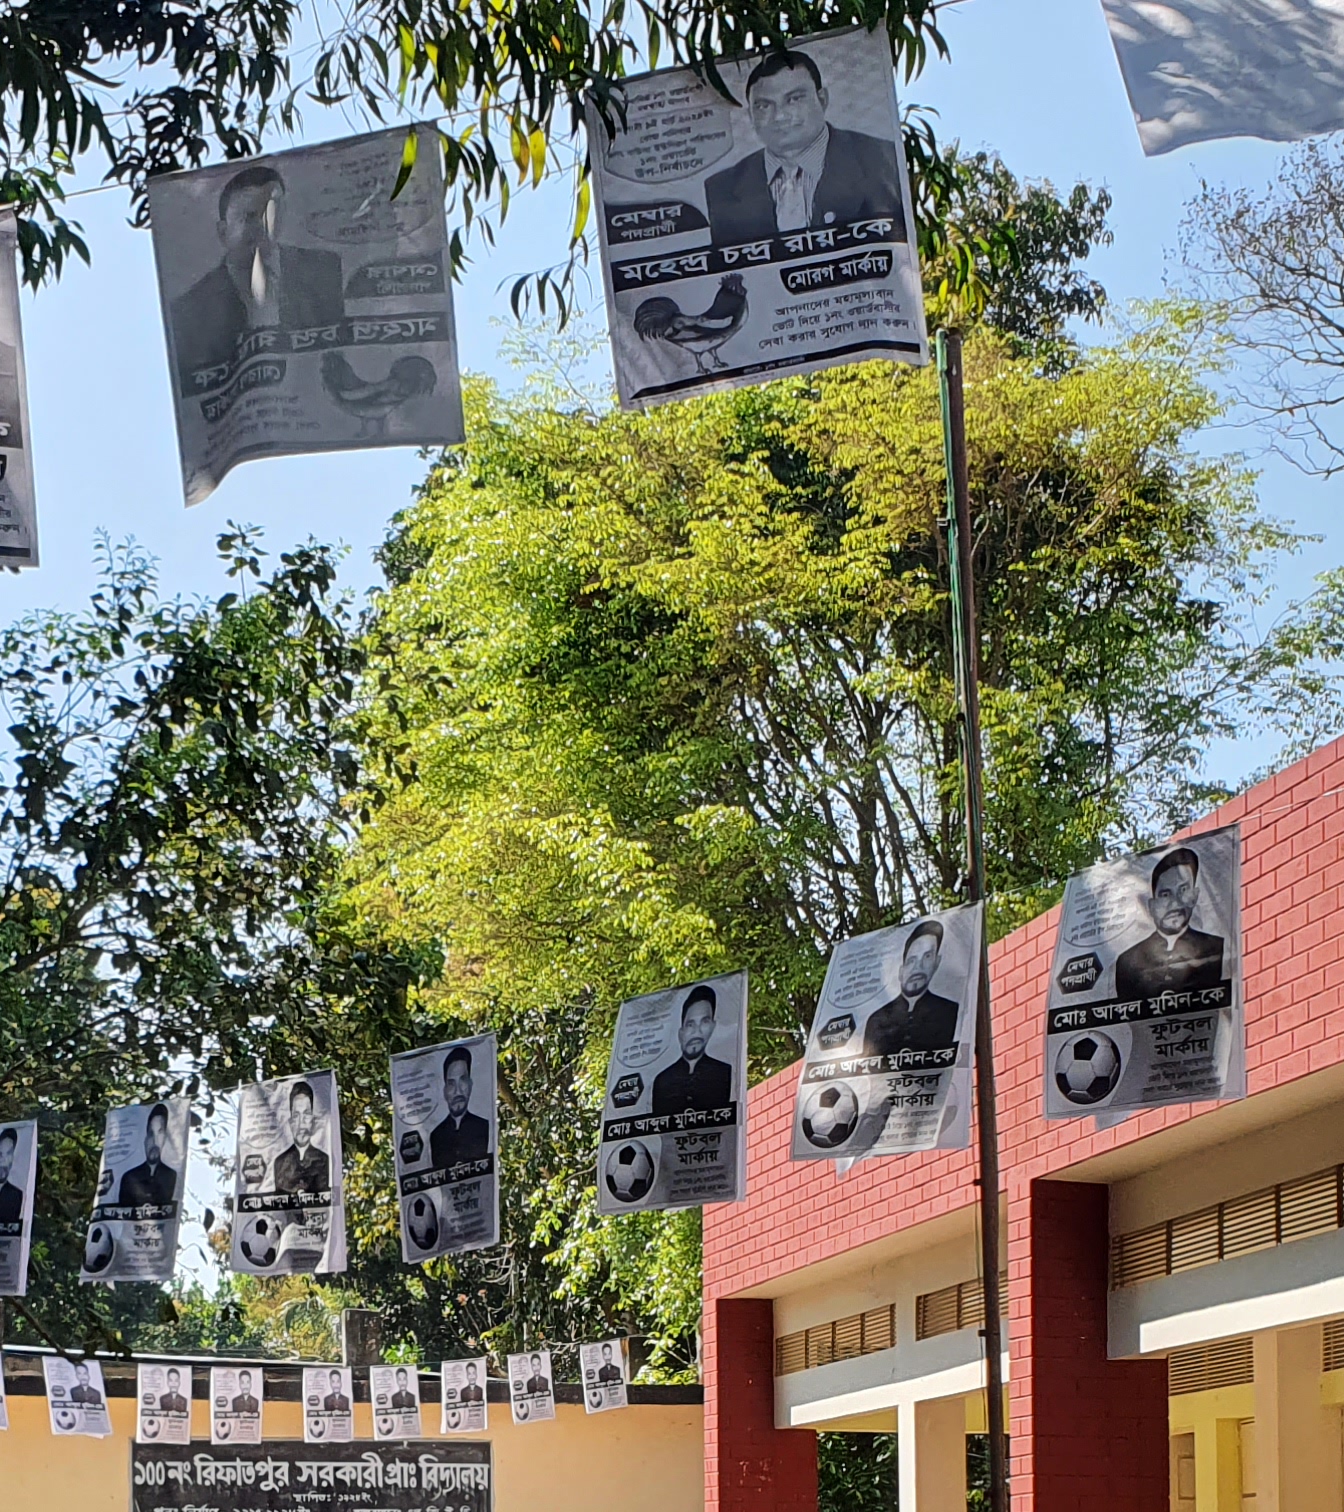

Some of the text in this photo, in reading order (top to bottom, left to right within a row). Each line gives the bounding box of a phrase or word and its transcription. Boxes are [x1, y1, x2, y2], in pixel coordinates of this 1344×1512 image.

[618, 250, 711, 282] মহেন্দ্র
[718, 239, 774, 265] চন্দ্র
[787, 251, 888, 289] মোরগ মার্কায়
[1054, 1010, 1087, 1028] মোঃ
[1092, 1000, 1142, 1021] আব্দুল
[1149, 1015, 1214, 1041] ফুটবল
[1154, 1036, 1210, 1058] মার্কায়
[808, 1063, 836, 1079] মোঃ
[840, 1054, 883, 1074] আব্দুল
[886, 1072, 942, 1093] ফুটবল
[889, 1088, 937, 1109] মার্কায়
[607, 1122, 630, 1137] মোঃ
[674, 1131, 722, 1150] ফুটবল
[193, 1453, 291, 1493] রিফাতপুর
[295, 1452, 384, 1489] সরকারী
[385, 1457, 417, 1489] প্রাঃ
[418, 1454, 490, 1500] বিদ্যালয়
